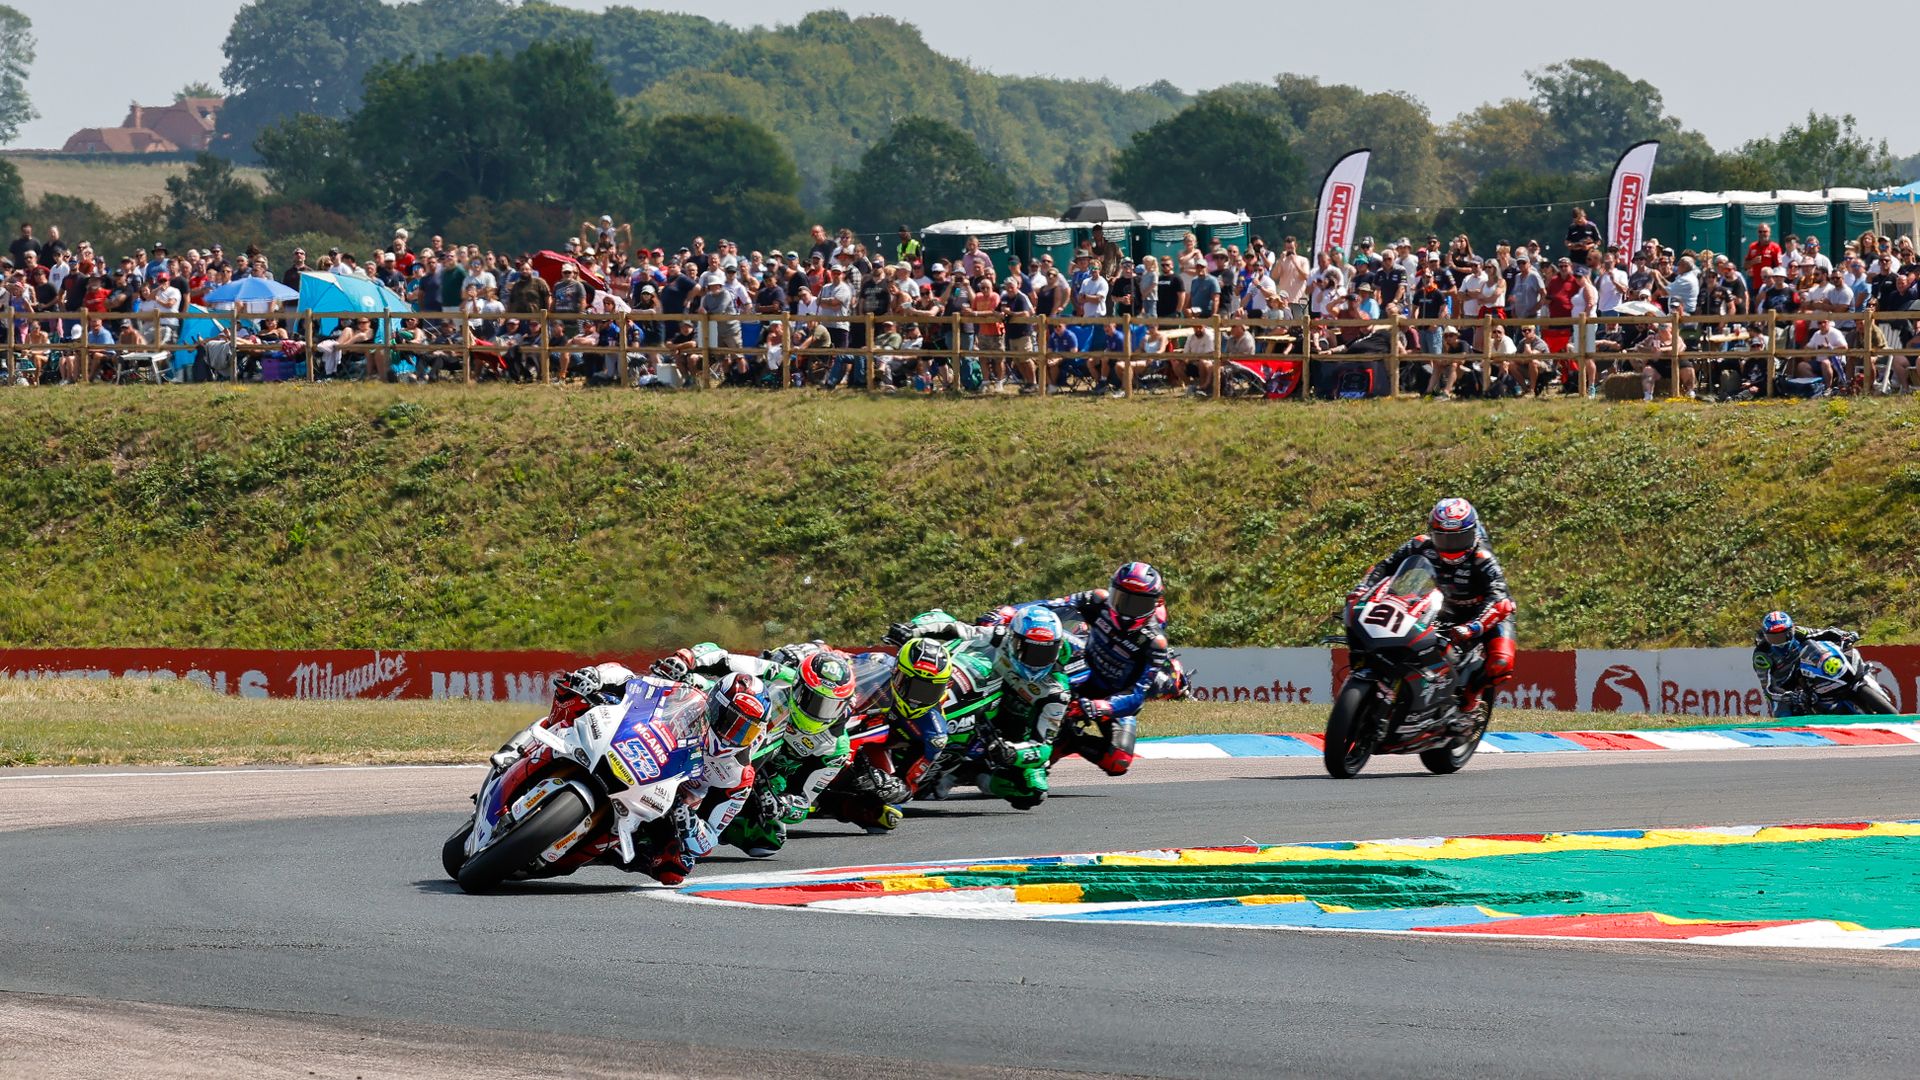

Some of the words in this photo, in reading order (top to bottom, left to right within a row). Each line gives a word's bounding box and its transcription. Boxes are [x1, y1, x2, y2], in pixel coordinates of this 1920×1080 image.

[1363, 604, 1405, 633] 91
[614, 738, 660, 780] 52
[634, 724, 667, 763] McAMS
